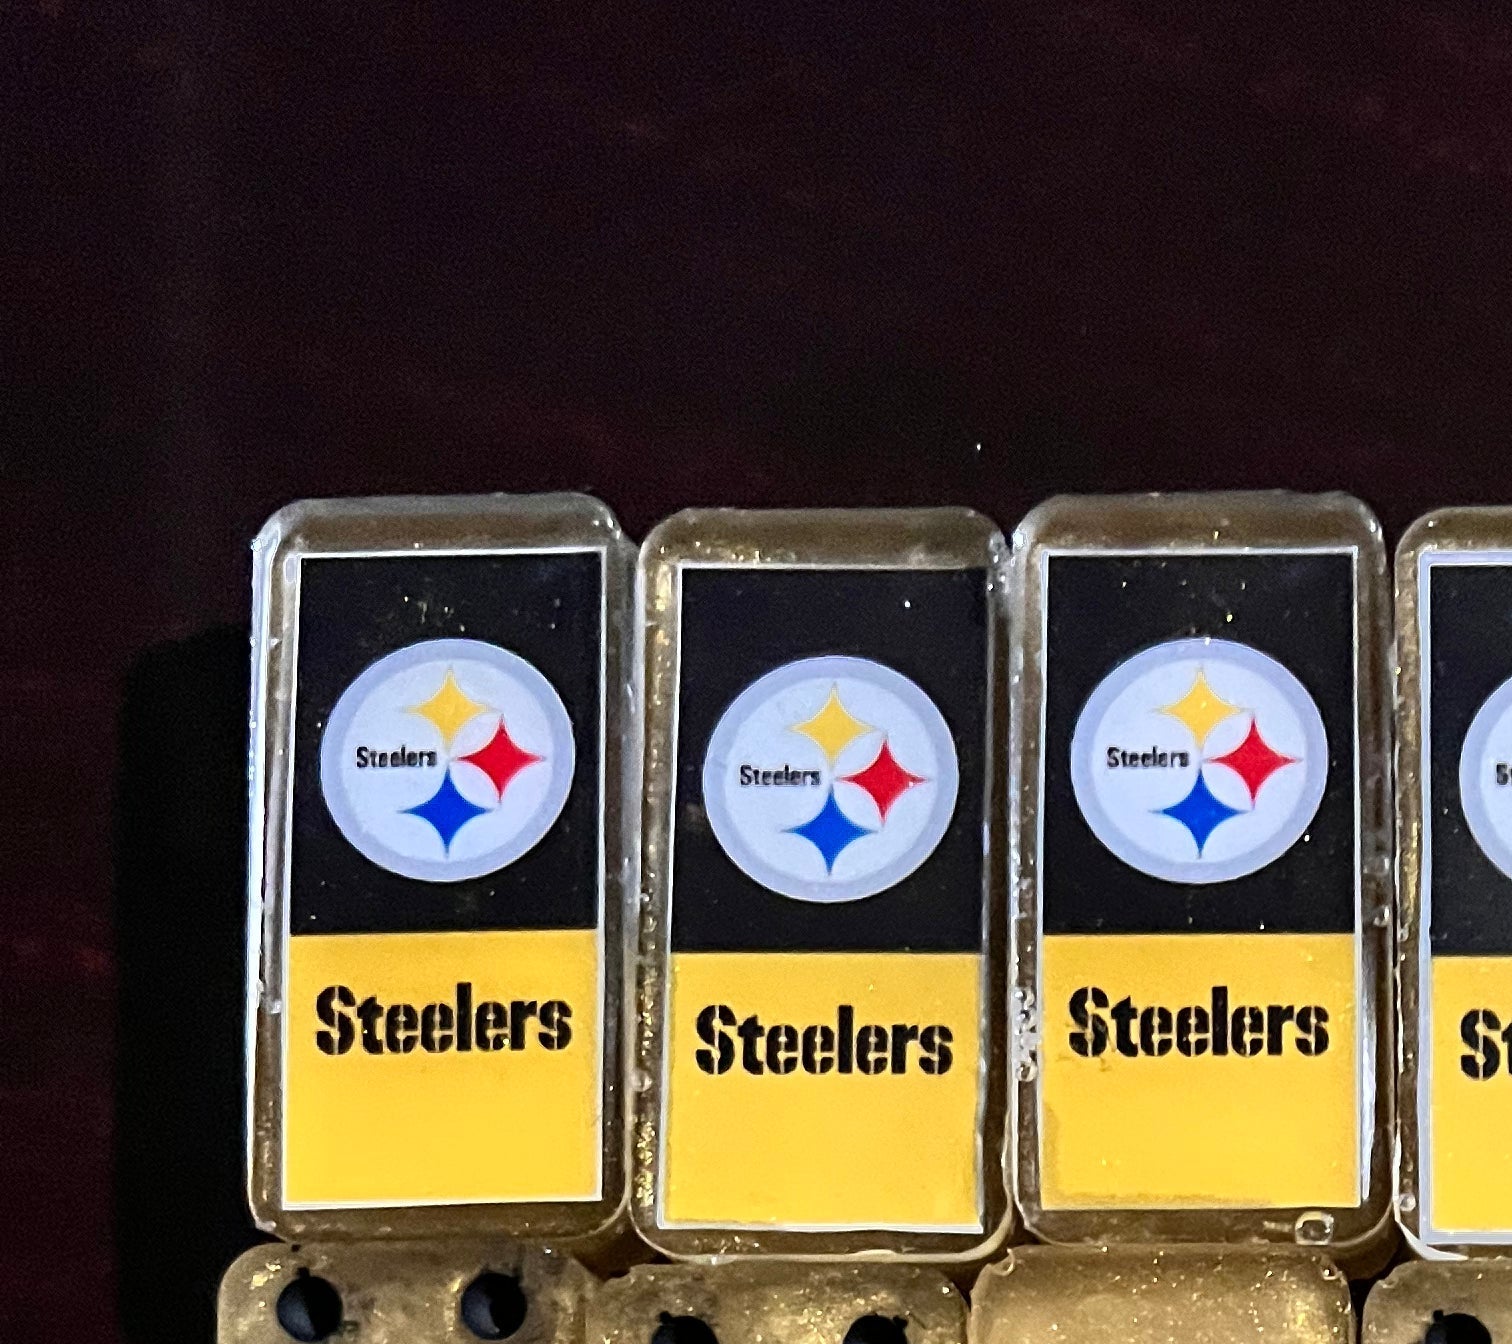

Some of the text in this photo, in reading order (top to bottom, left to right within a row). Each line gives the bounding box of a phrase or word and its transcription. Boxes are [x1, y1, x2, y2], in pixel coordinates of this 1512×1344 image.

[356, 744, 437, 769] Steelers
[740, 763, 821, 788] Steelers
[1107, 745, 1189, 769] Steelers
[317, 982, 571, 1055] Steelers
[696, 1005, 953, 1075] Steelers
[1069, 986, 1329, 1057] Steelers
